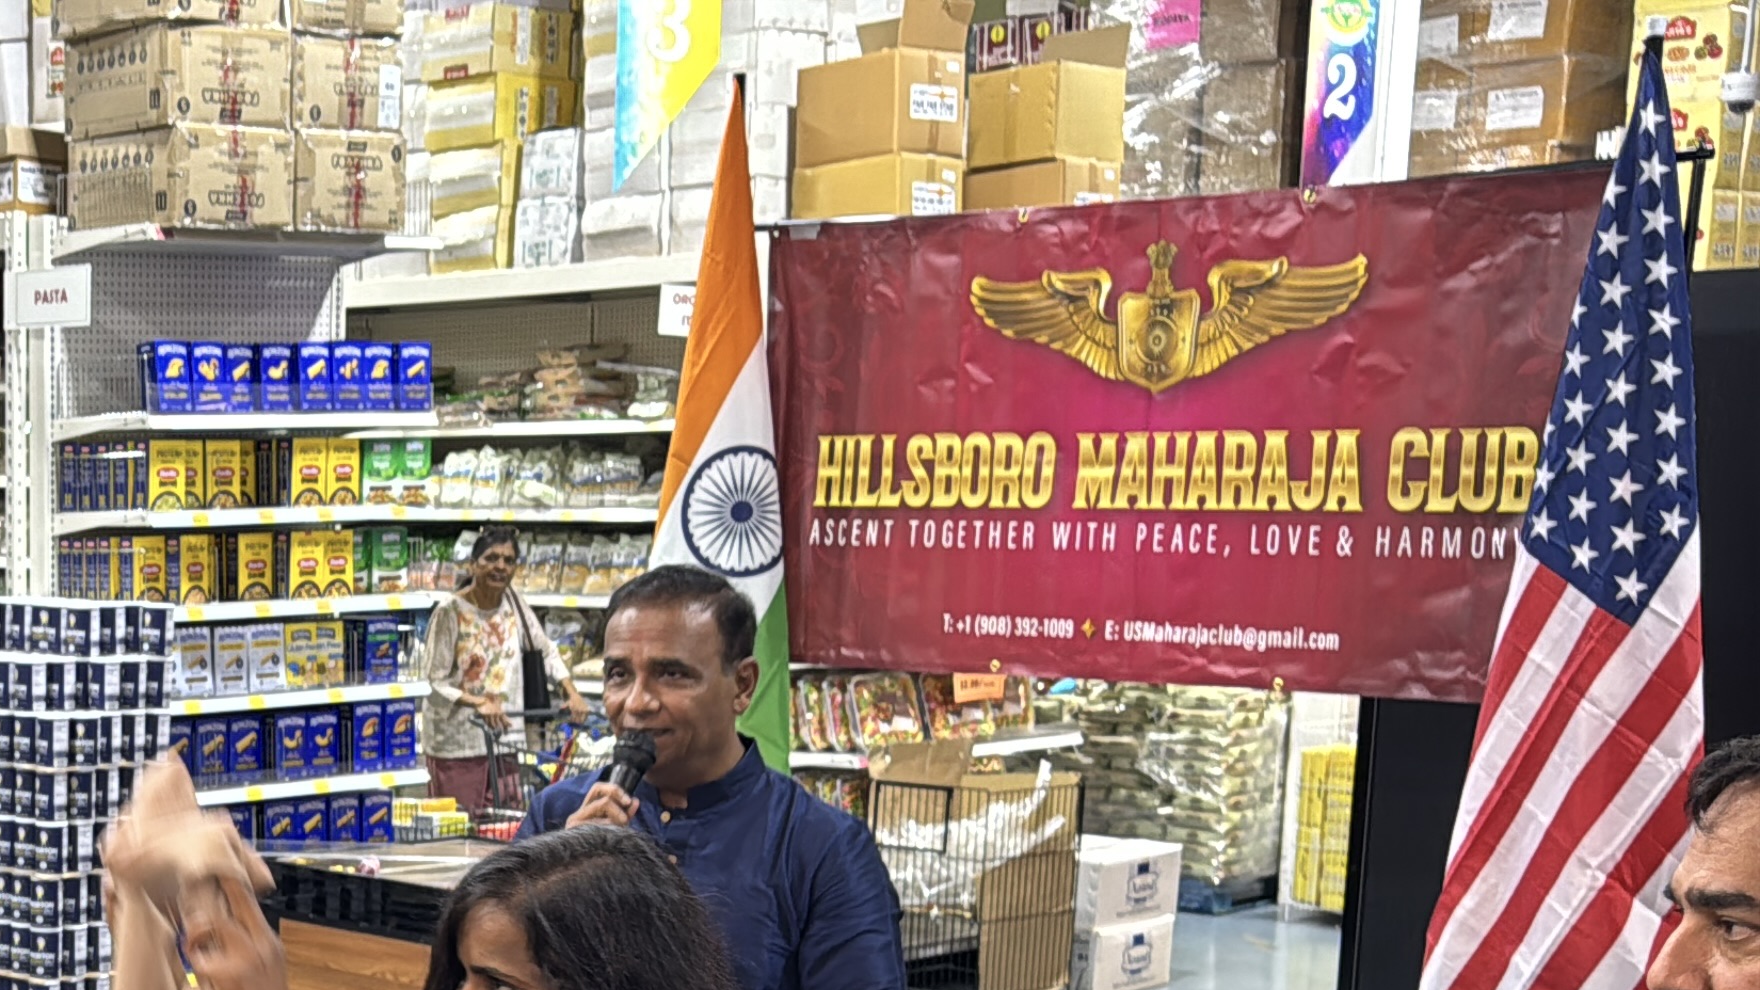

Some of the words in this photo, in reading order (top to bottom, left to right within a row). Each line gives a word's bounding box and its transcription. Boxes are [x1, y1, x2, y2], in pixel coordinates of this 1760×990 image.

[644, 0, 691, 64] 3
[1323, 53, 1357, 120] 2
[33, 287, 69, 306] PASTA
[813, 431, 1057, 509] HILLSBORO
[1072, 429, 1364, 512] MAHARAJA
[1387, 426, 1539, 513] CLUB
[809, 517, 895, 548] ASCENT
[909, 518, 1036, 551] TOGETHER
[1052, 520, 1117, 552] WITH
[1135, 521, 1231, 559] PEACE,
[1250, 523, 1322, 558] LOVE
[1336, 524, 1354, 558] &
[943, 612, 955, 634] T:
[956, 614, 972, 635] +1
[975, 613, 1012, 639] (908)
[1014, 615, 1075, 639] 392-1009
[1104, 619, 1121, 642] E:
[1123, 620, 1341, 653] USMaharajaclub@gmail.com
